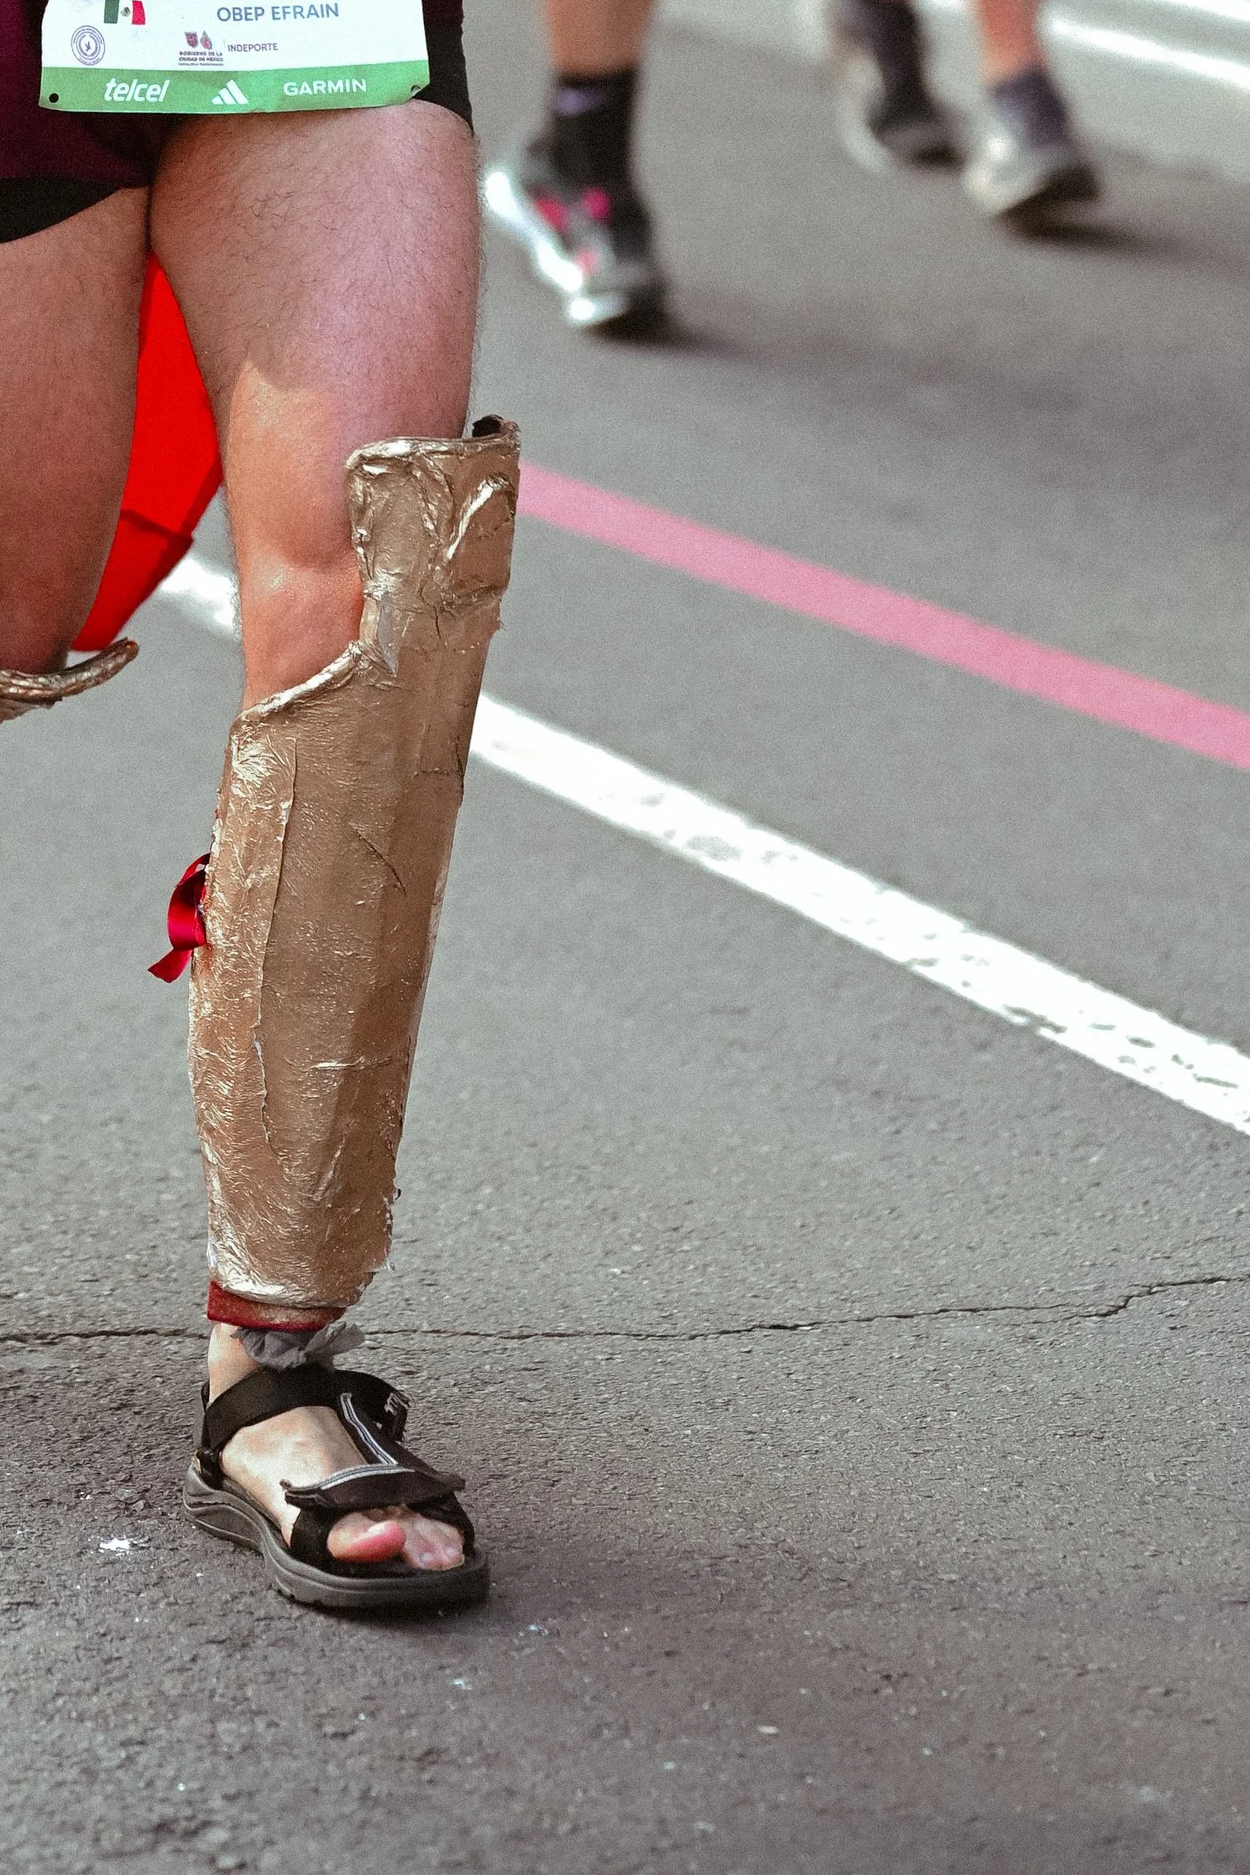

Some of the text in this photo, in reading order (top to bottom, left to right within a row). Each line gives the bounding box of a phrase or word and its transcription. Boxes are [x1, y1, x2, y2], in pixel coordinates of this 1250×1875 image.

[217, 3, 340, 22] OBEP EFRAIN
[227, 42, 279, 53] INDEPORTE
[104, 78, 170, 103] telcel
[283, 78, 367, 97] GARMIN
